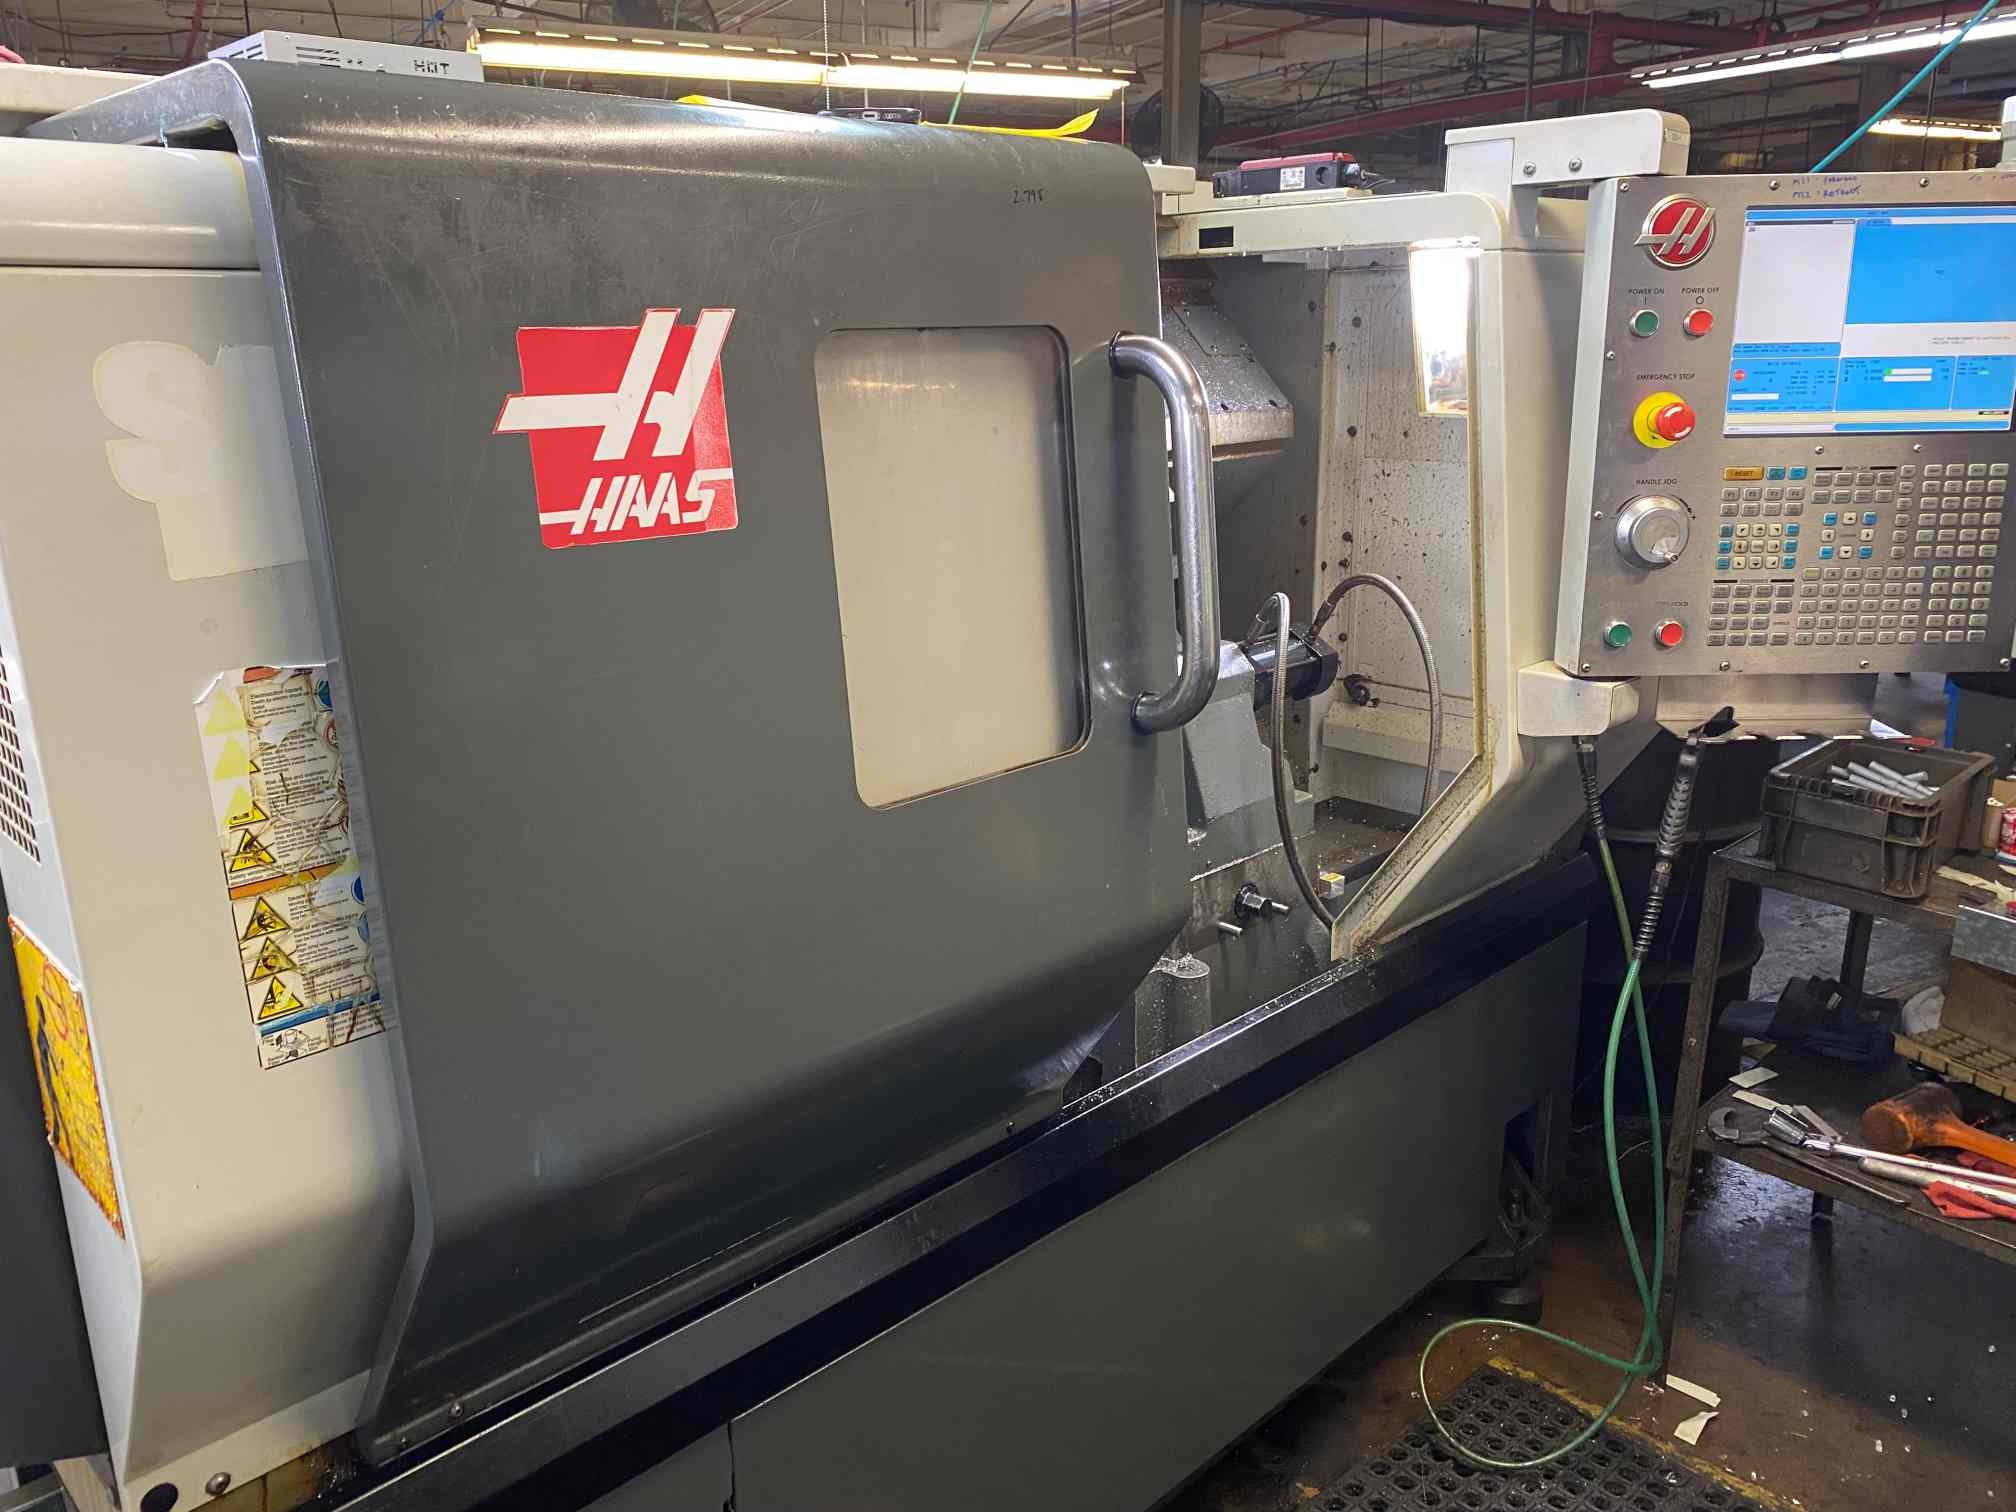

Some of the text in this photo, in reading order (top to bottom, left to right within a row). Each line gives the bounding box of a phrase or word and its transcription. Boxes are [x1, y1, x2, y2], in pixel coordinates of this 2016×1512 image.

[1636, 372, 1696, 381] EMERGENCY STOP
[540, 466, 735, 536] HAAS
